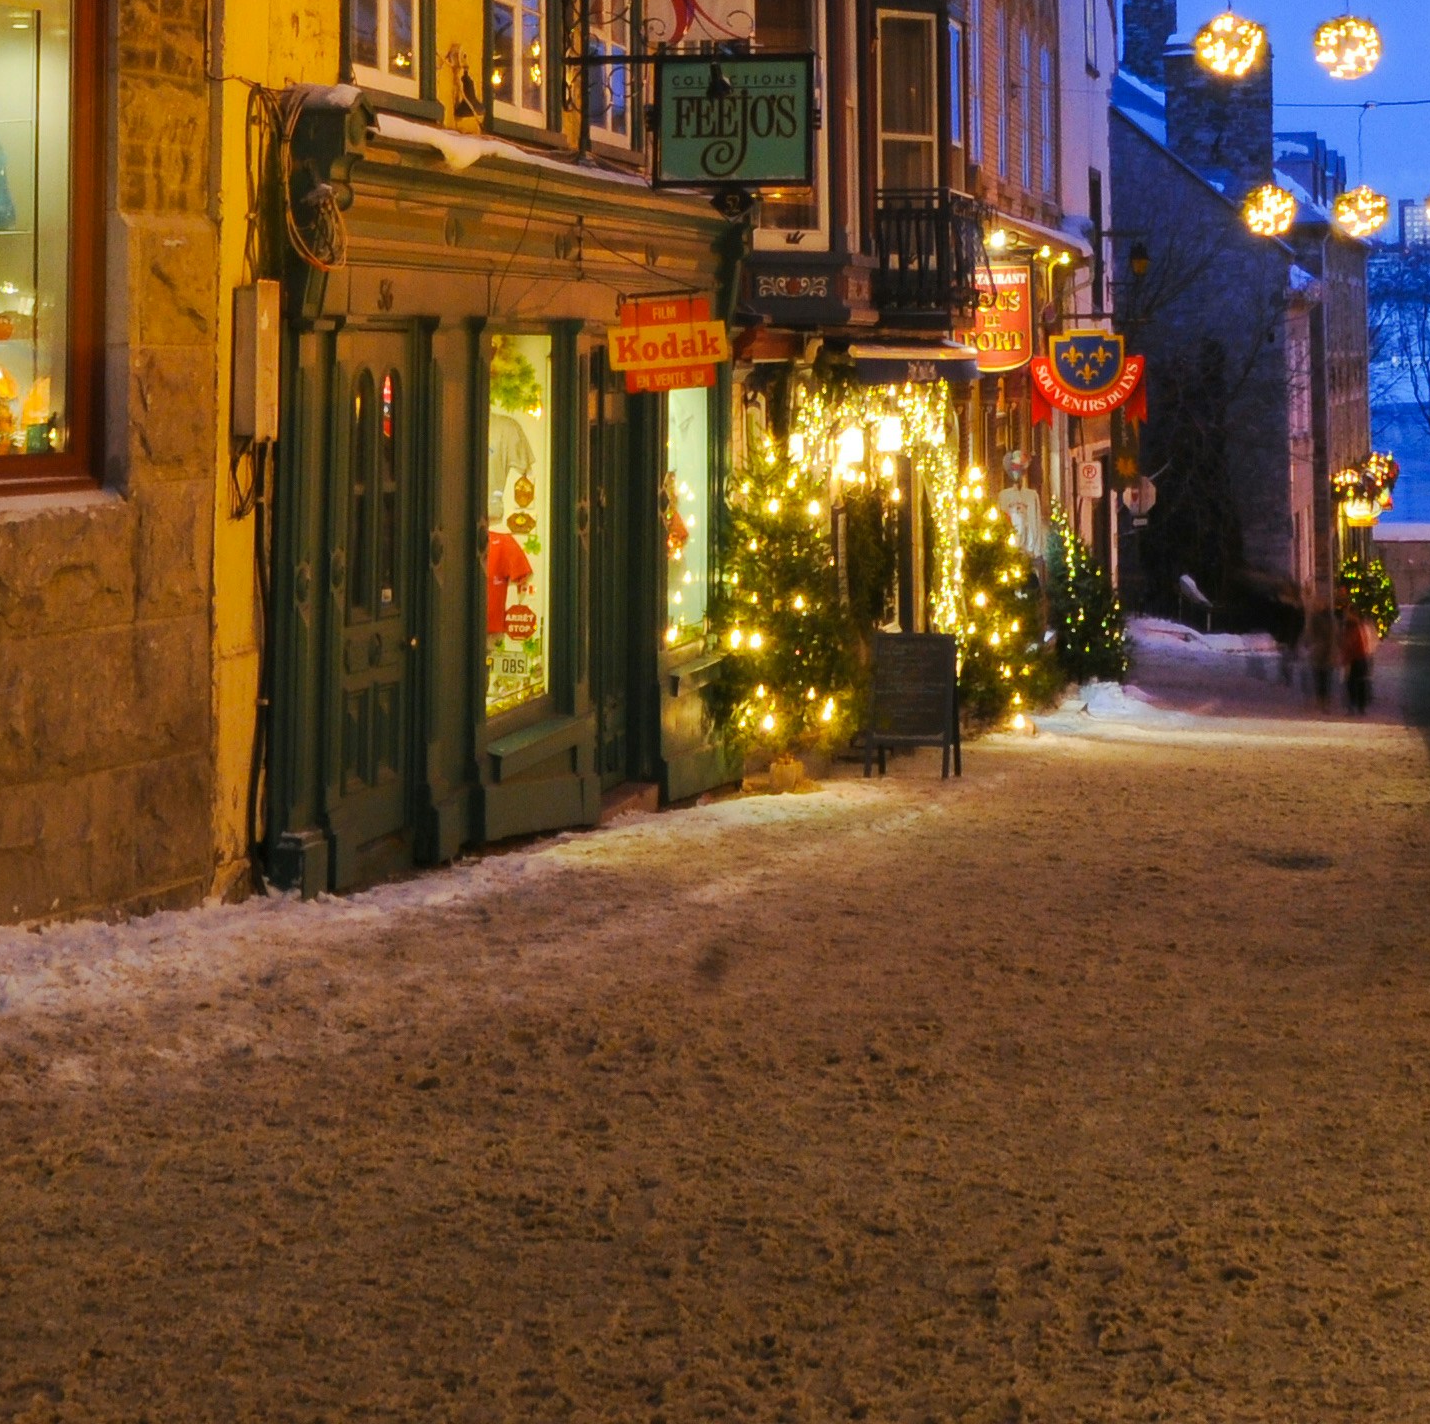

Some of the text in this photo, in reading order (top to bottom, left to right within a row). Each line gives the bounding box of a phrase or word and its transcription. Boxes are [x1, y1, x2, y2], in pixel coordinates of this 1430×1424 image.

[671, 73, 798, 87] COLCTIONS
[977, 290, 1021, 313] OUS
[652, 305, 677, 320] FILM
[615, 329, 721, 363] Kodak
[636, 375, 650, 389] EN
[653, 372, 687, 387] VENTE
[1036, 362, 1139, 412] SOUVENIRS DU LYS
[508, 624, 531, 633] STOP
